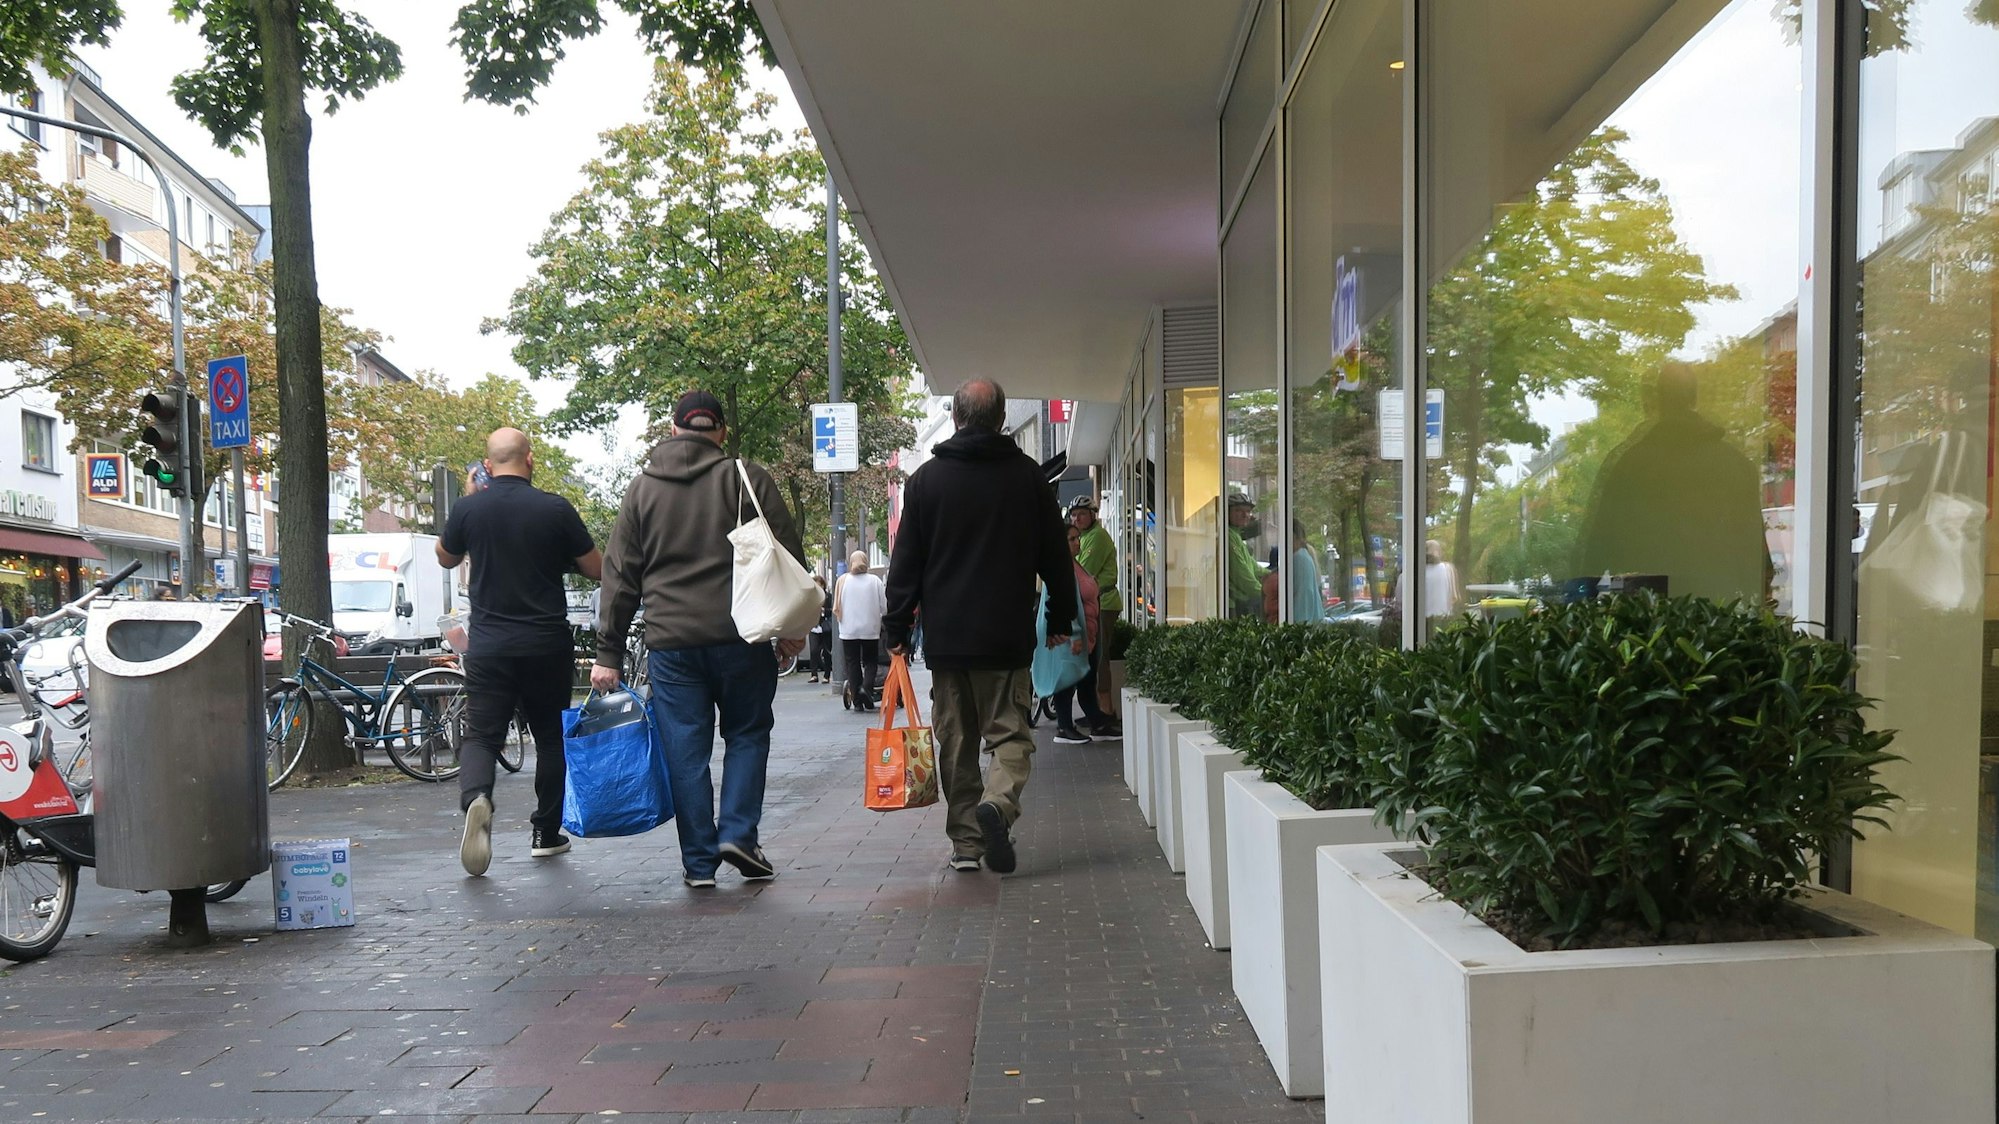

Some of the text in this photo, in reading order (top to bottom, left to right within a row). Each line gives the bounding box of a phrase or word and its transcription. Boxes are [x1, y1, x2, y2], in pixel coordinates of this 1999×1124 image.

[214, 418, 246, 440] TAXI
[92, 478, 118, 488] ALDI
[293, 865, 329, 874] babylove
[281, 908, 289, 918] 5
